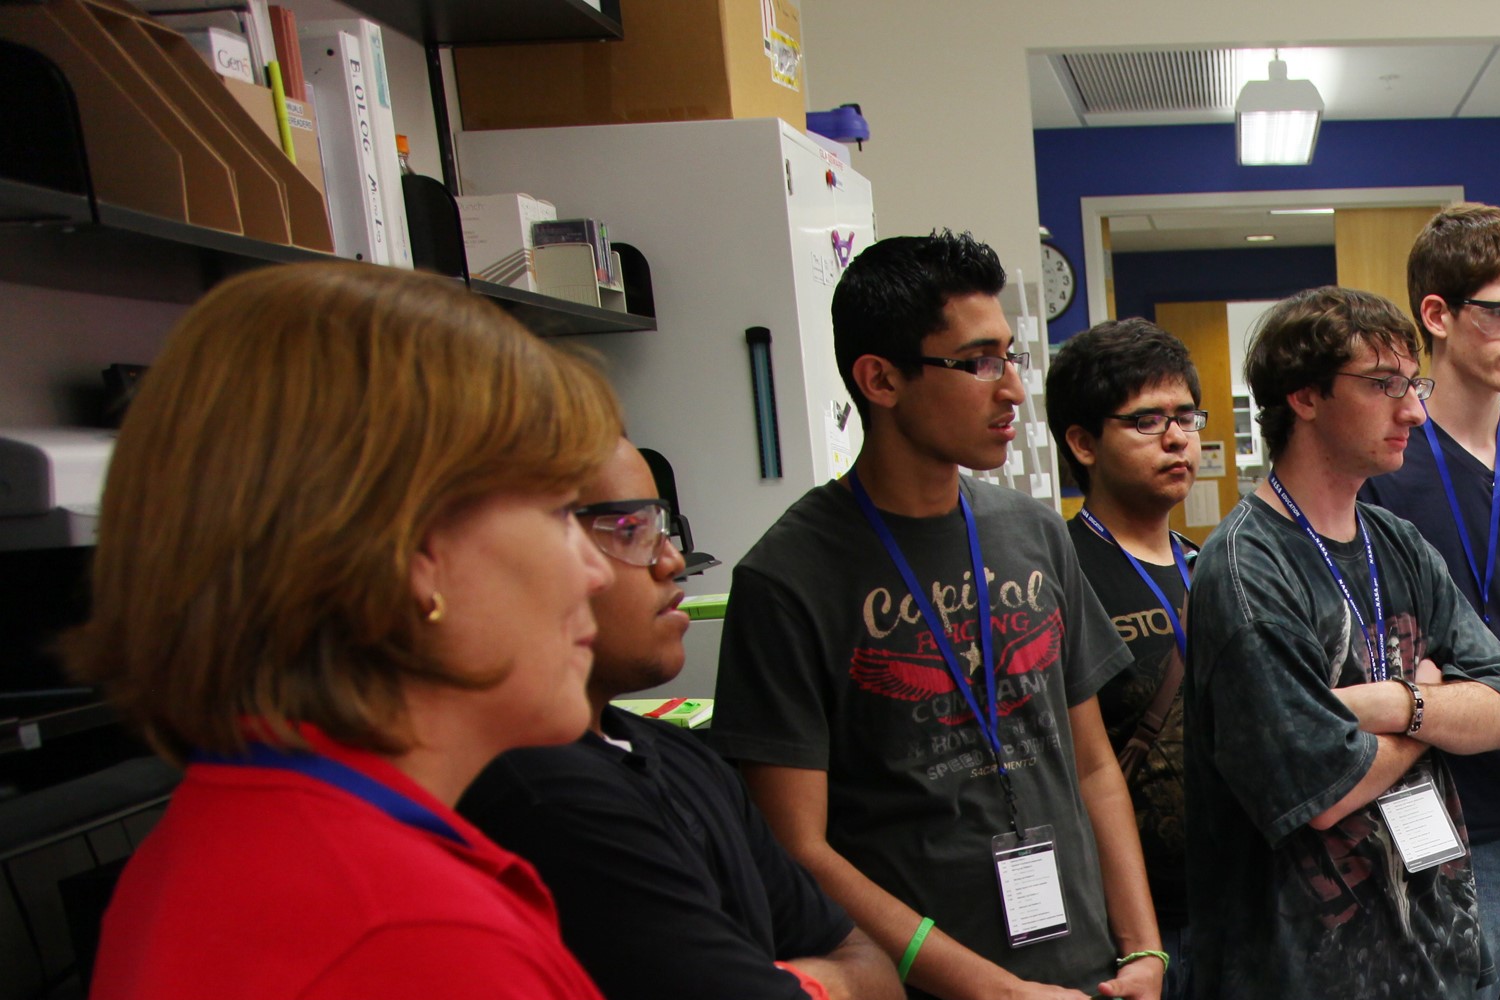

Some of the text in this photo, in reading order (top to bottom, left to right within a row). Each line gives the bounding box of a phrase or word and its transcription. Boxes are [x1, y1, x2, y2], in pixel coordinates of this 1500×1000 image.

[1045, 249, 1050, 260] 1
[1056, 261, 1064, 272] 2
[1063, 275, 1070, 286] 3
[1059, 291, 1066, 300] 4
[1049, 303, 1056, 313] 5
[915, 611, 1030, 654] RACNG
[912, 672, 1050, 723] COMANY
[970, 757, 1037, 779] SACRMENTO
